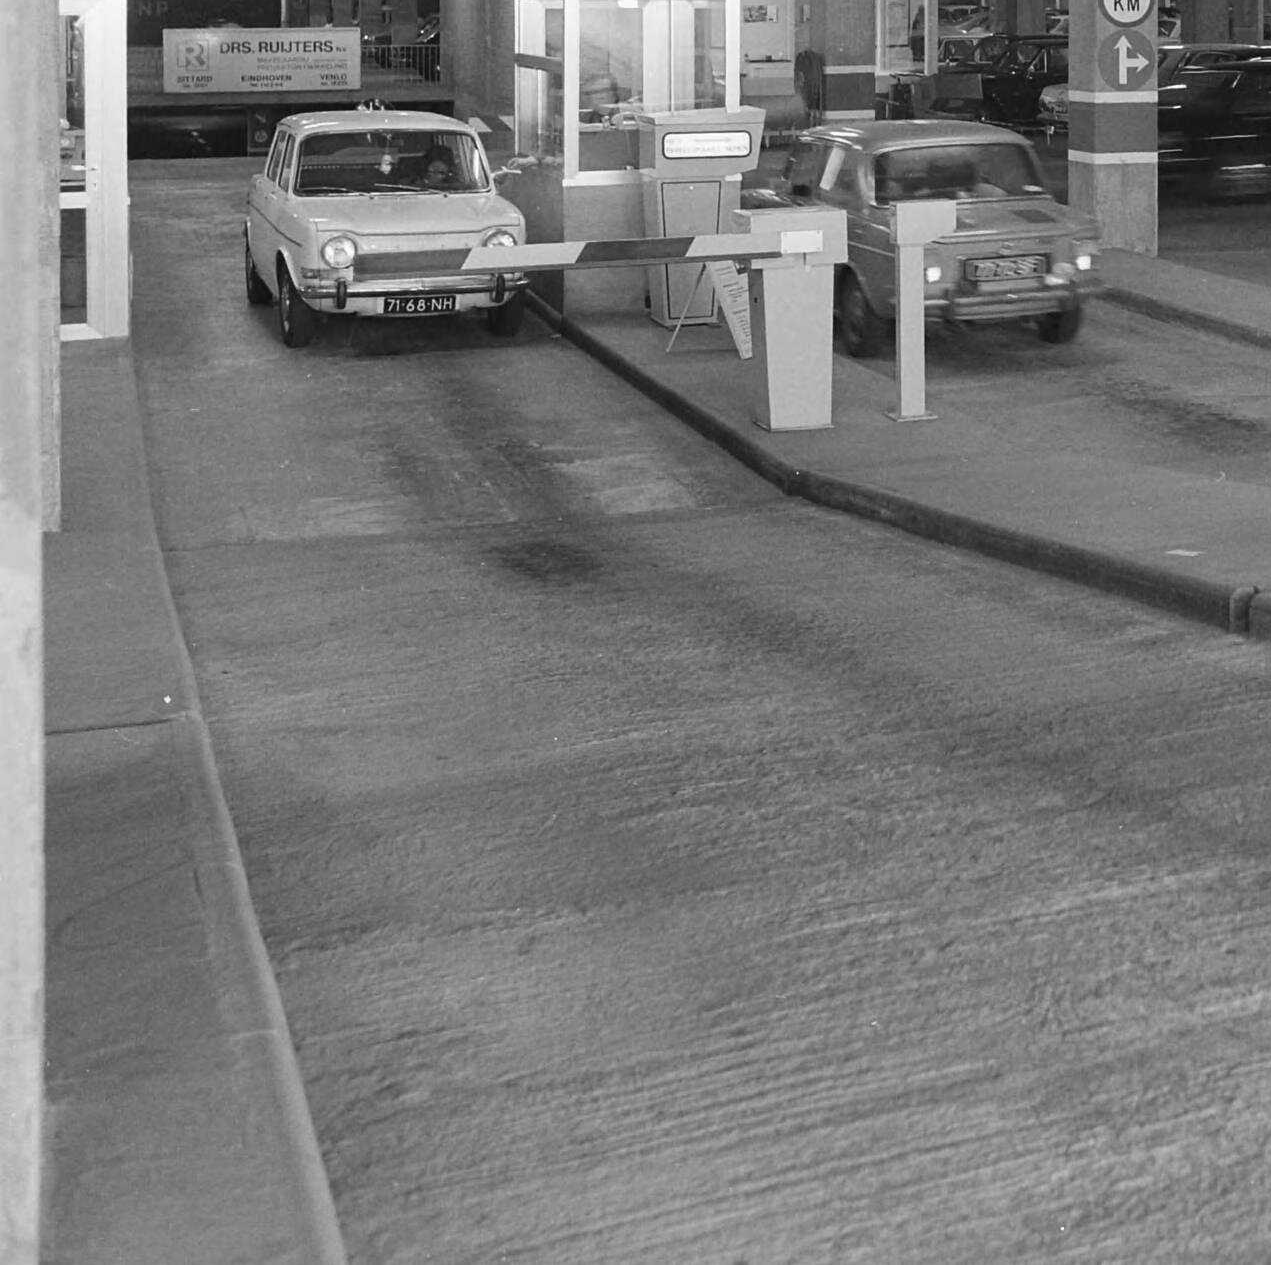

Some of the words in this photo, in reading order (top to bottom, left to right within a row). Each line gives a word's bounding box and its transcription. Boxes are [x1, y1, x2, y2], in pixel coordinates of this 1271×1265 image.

[219, 41, 255, 54] DRS.
[257, 40, 334, 54] RUIJTERS
[240, 74, 293, 83] EINDHOVEN
[319, 73, 348, 82] VENLO
[386, 297, 453, 312] 71-68-NH
